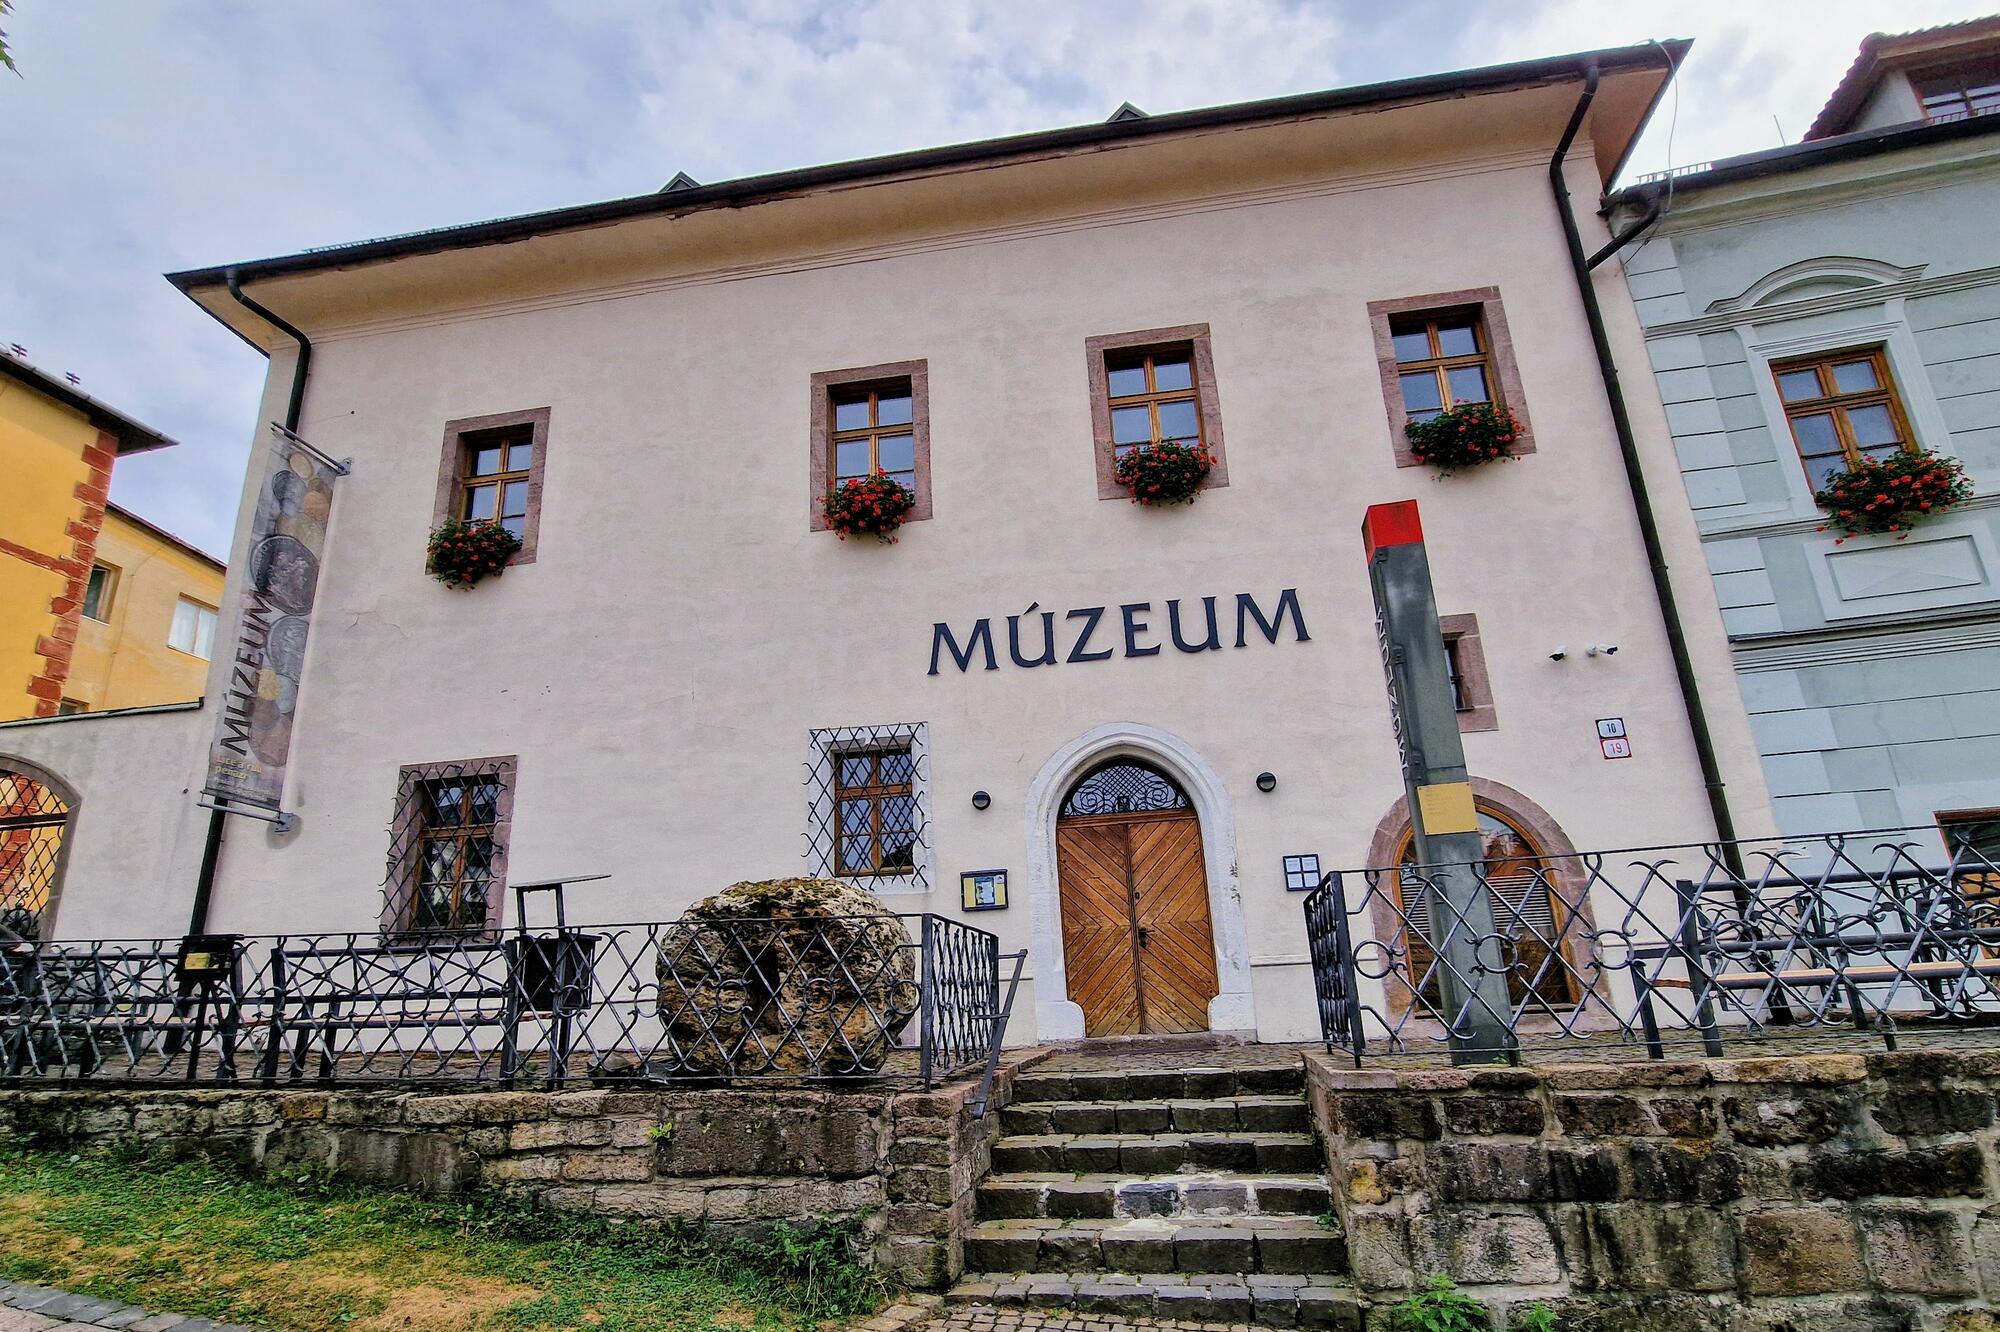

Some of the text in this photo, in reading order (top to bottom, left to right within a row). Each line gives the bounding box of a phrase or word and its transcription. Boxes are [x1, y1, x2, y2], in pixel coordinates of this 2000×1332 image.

[926, 587, 1312, 675] MÚZEUM
[220, 588, 274, 757] MÚZEUM
[1606, 723, 1617, 734] 10
[1610, 742, 1623, 754] 19
